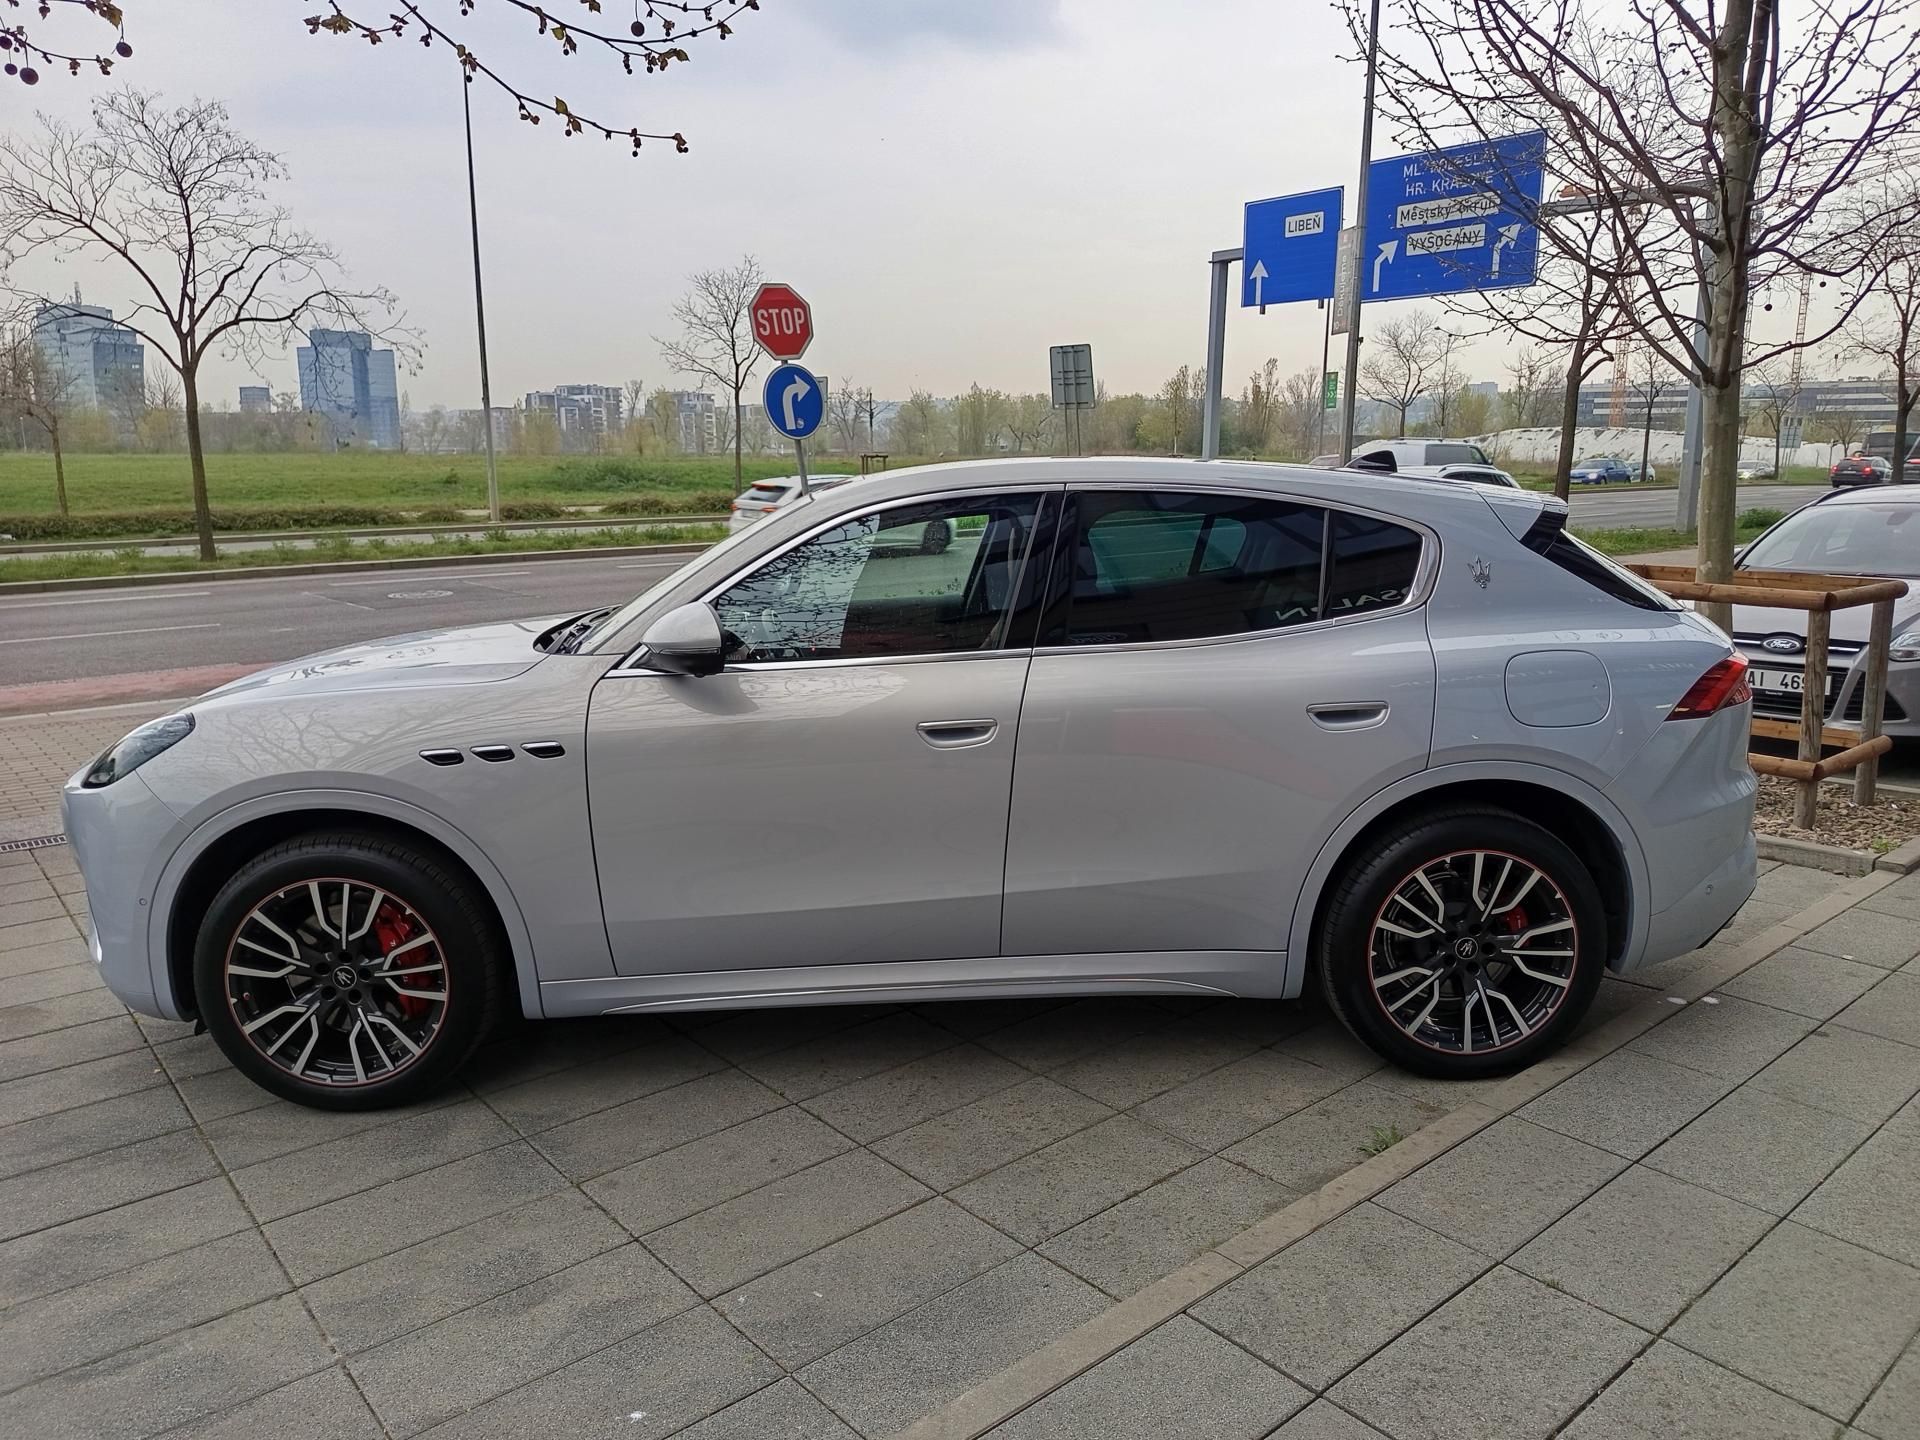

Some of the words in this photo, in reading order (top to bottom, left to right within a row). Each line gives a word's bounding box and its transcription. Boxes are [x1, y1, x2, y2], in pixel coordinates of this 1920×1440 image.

[1403, 163, 1424, 178] ML.
[1430, 149, 1498, 173] OLESLA
[1405, 182, 1426, 197] HR.
[1288, 214, 1321, 233] LIBEŇ
[1409, 229, 1482, 251] VYSOČANY
[757, 308, 805, 335] STOP
[1770, 639, 1792, 649] Ford
